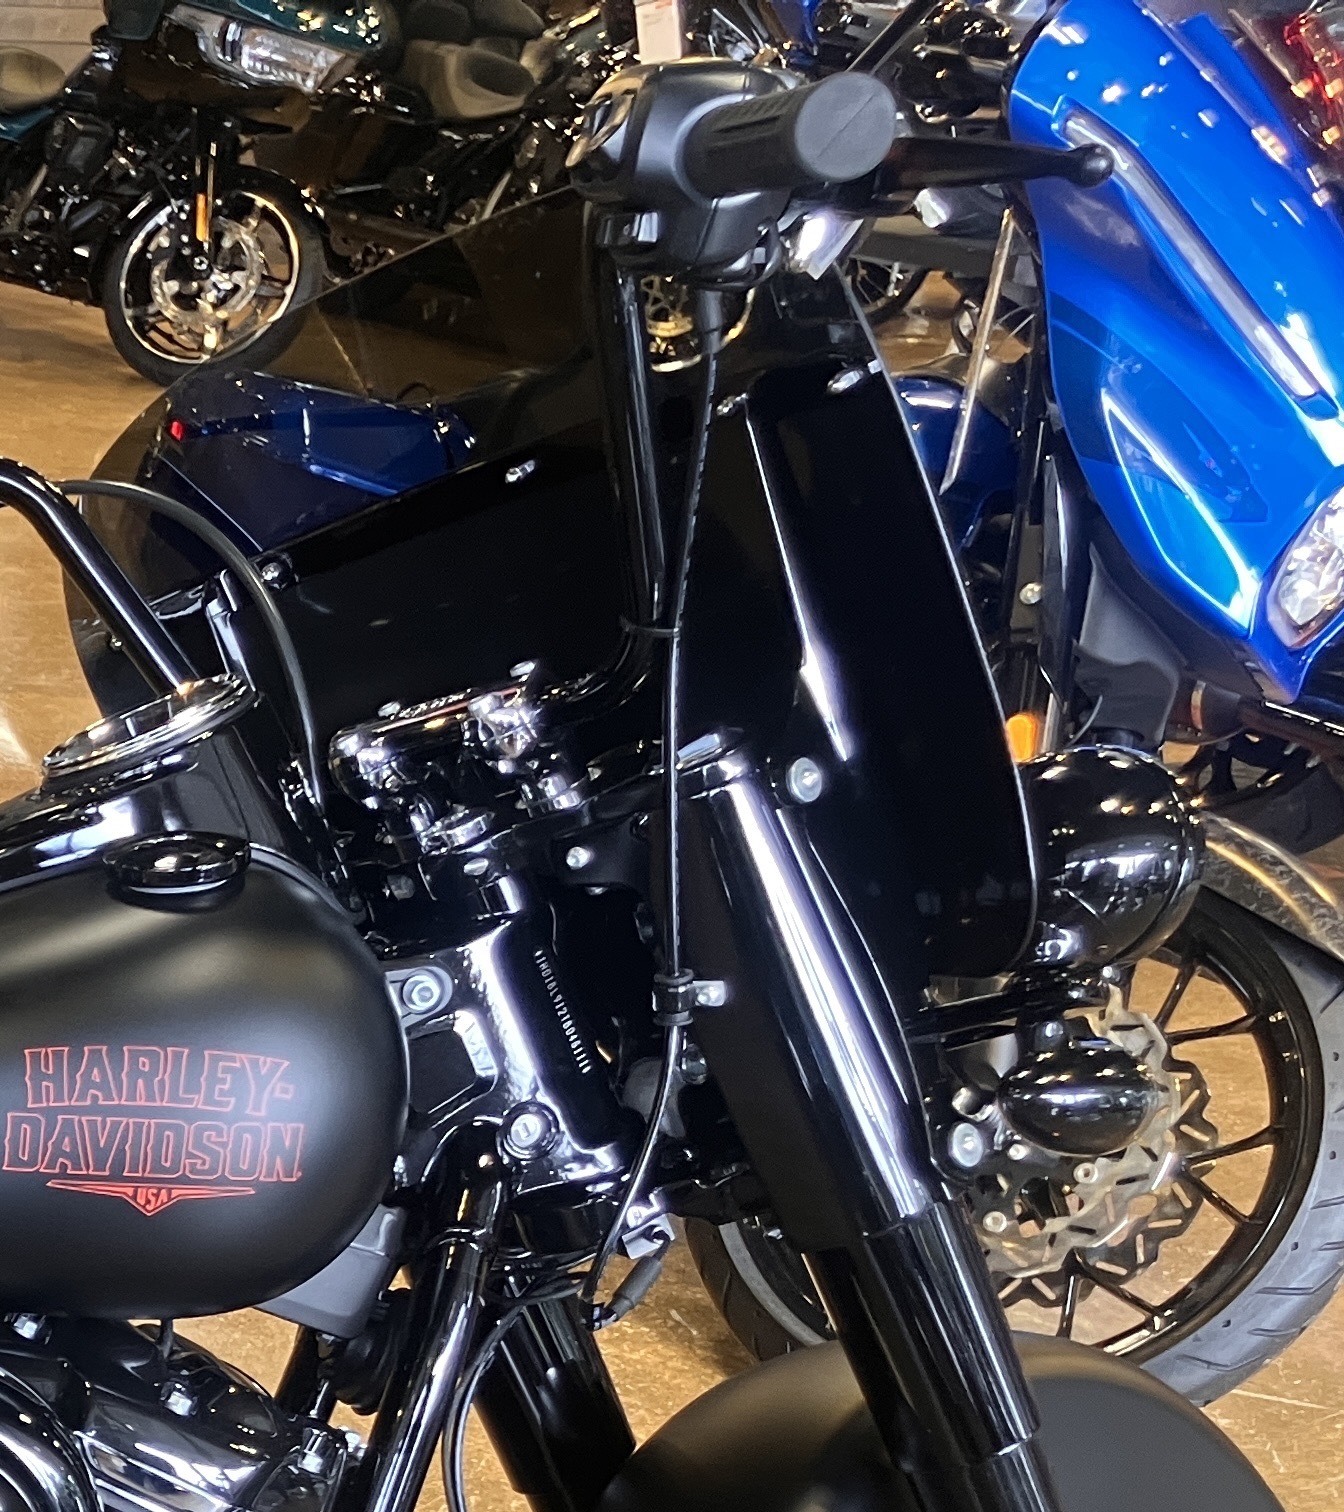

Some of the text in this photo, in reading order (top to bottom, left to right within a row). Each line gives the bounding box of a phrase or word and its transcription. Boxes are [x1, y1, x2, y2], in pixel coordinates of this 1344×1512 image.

[24, 1045, 295, 1117] HARLEY-
[2, 1112, 305, 1183] DAVIDSON
[135, 1186, 171, 1211] USA
